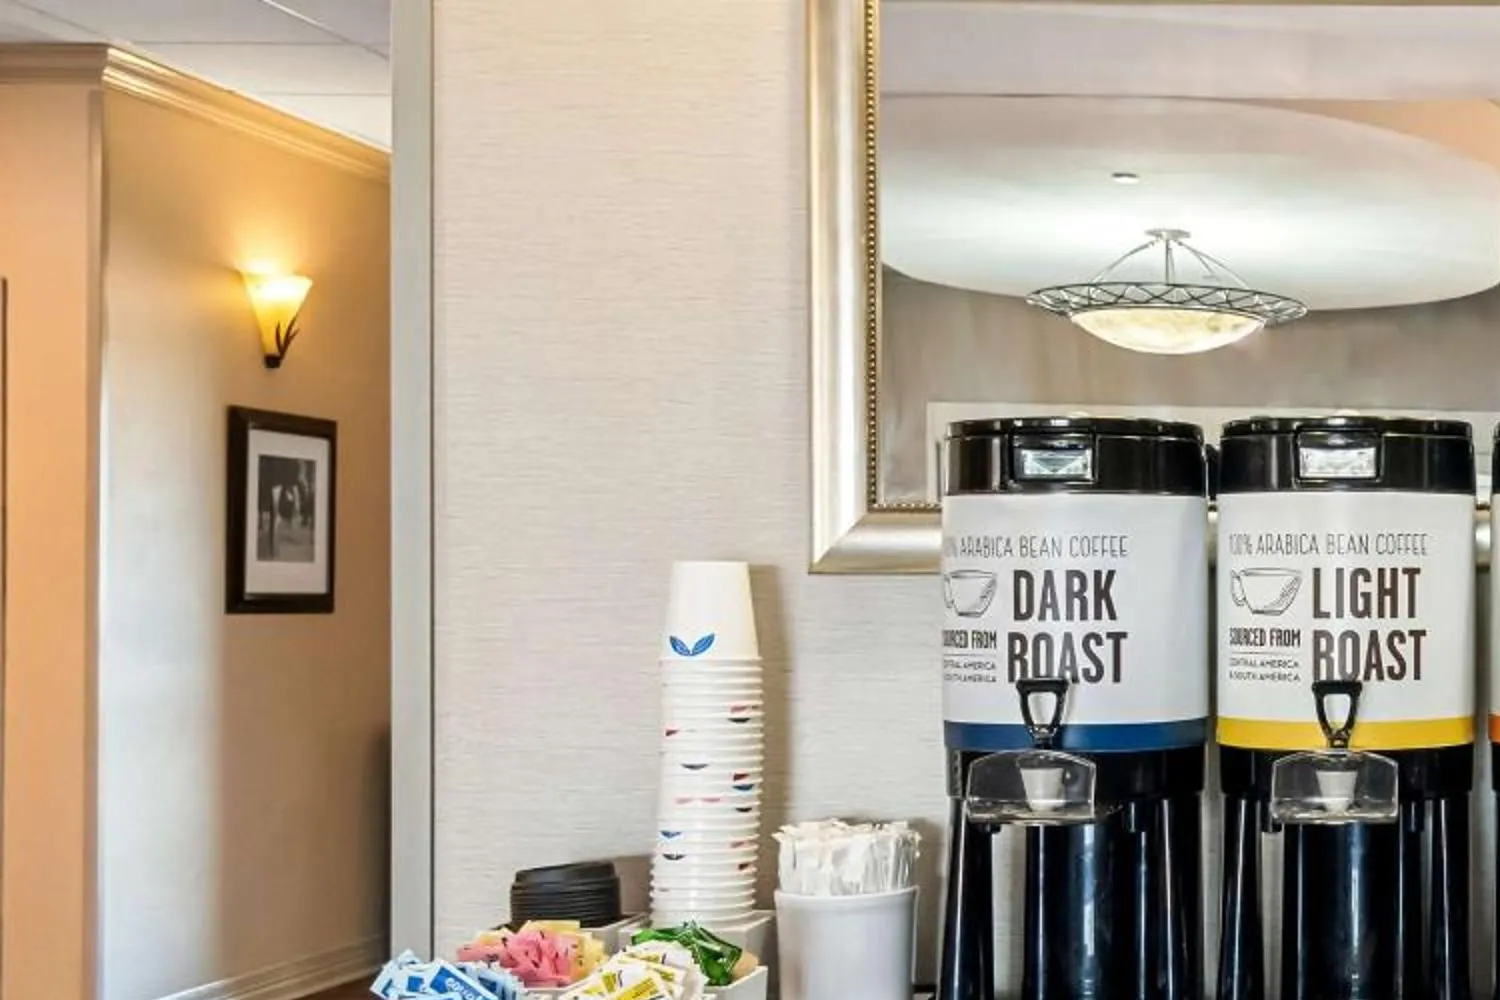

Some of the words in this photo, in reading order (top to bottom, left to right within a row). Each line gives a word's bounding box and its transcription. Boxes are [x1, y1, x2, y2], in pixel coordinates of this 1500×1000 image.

[960, 535, 1013, 559] ARABICA
[1019, 535, 1063, 559] BEAN
[1069, 535, 1129, 558] COFFEE
[1257, 533, 1320, 555] ARABICA
[1326, 533, 1369, 556] BEAN
[1375, 533, 1429, 556] COFFEE
[1013, 569, 1118, 622] DARK
[1312, 566, 1422, 619] LIGHT
[971, 629, 997, 650] FROM
[1229, 626, 1267, 647] SOURCED
[1269, 627, 1301, 648] FROM
[1007, 631, 1129, 684] ROAST
[1259, 659, 1300, 670] AMERICA
[1311, 629, 1427, 682] ROAST
[1258, 672, 1301, 682] AMERICA
